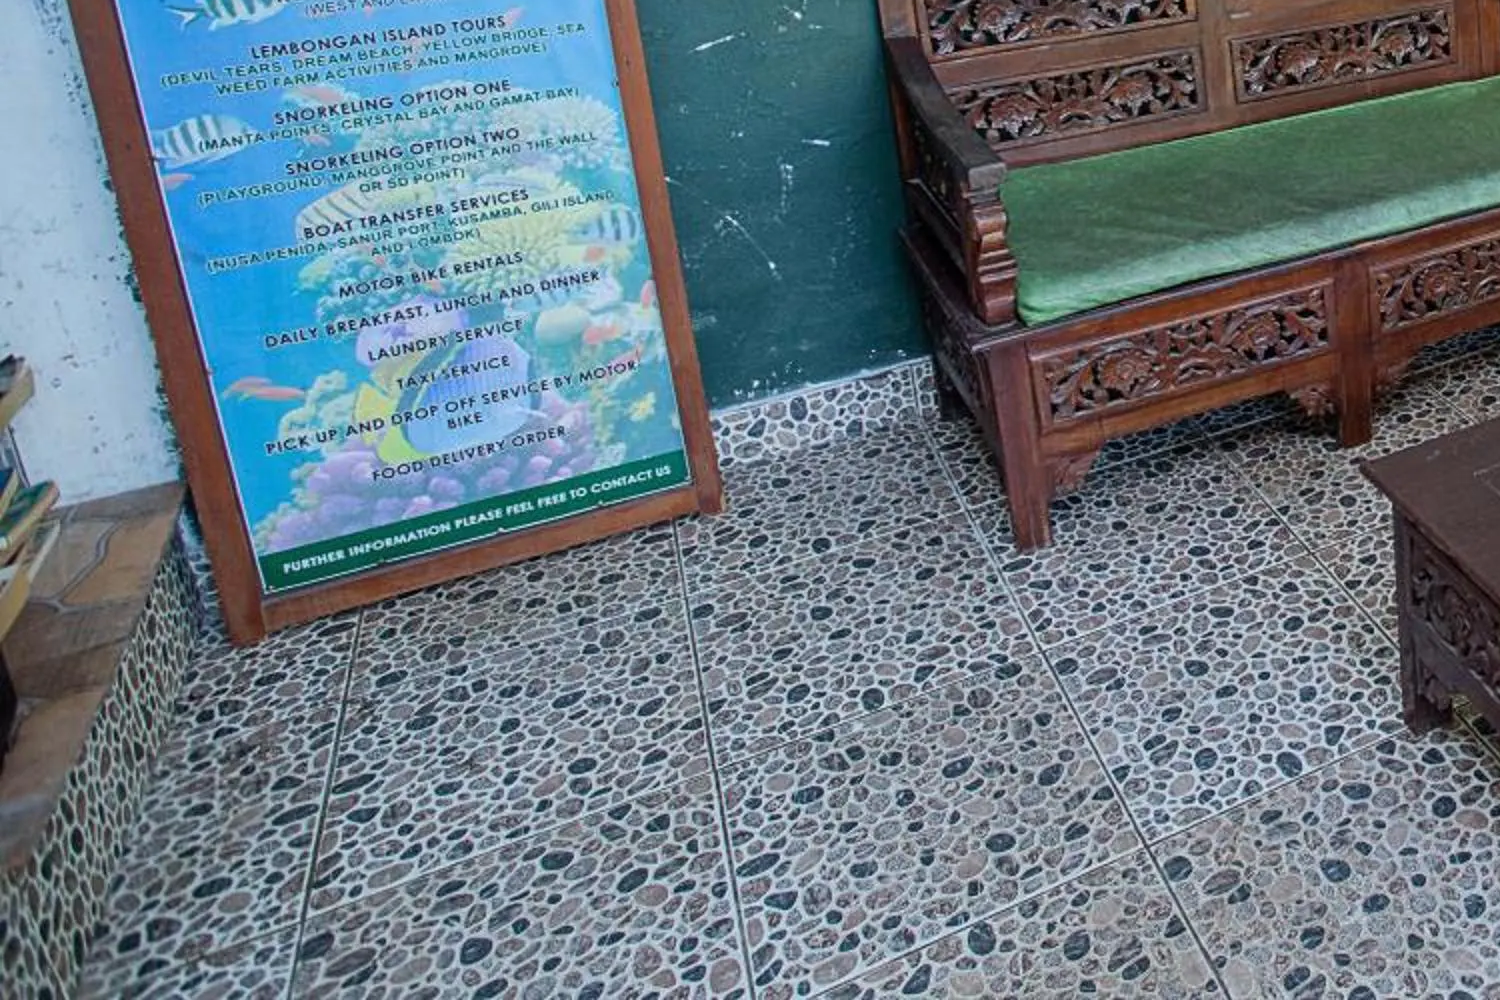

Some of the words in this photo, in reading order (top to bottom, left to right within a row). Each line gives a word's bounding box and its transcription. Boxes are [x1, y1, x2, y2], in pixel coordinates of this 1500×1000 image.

[305, 0, 356, 17] (WEST
[160, 74, 215, 89] (DEVIL
[292, 53, 352, 70] DREAM
[424, 34, 486, 52] YELLOW
[557, 22, 585, 36] SEA
[251, 32, 375, 59] LEMBONGAN
[383, 24, 446, 42] ISLAND
[452, 16, 506, 34] TOURS
[215, 79, 267, 95] WEED
[273, 71, 319, 87] FARM
[325, 61, 417, 82] ACTIVITIES
[418, 54, 449, 69] AND
[455, 44, 547, 64] MANGROVE)
[199, 134, 265, 153] (MANTA
[341, 111, 415, 131] CRYSTAL
[419, 105, 447, 119] BAY
[453, 99, 485, 113] AND
[489, 91, 540, 108] GAMAT
[274, 97, 393, 125] SNORKELING
[400, 87, 467, 107] OPTION
[473, 79, 511, 95] ONE
[285, 145, 403, 176] SNORKELING
[409, 134, 476, 155] OPTION
[482, 127, 520, 142] TWO
[332, 156, 438, 182] MANGGROVE
[441, 149, 484, 165] POINT
[491, 143, 521, 157] AND
[526, 137, 555, 151] THE
[559, 131, 598, 146] WALL
[359, 181, 382, 193] OR
[387, 175, 409, 189] SD
[413, 168, 465, 184] POINT)
[206, 253, 262, 275] (NUSA
[338, 230, 393, 249] SANUR
[449, 207, 528, 227] KUSAMBA,
[562, 190, 614, 208] ISLAND
[304, 218, 352, 240] BOAT
[360, 201, 445, 228] TRANSFER
[451, 188, 529, 212] SERVICES
[371, 243, 403, 258] AND
[408, 227, 481, 250] LOMBOK)
[338, 274, 404, 299] MOTOR
[411, 265, 447, 284] BIKE
[453, 251, 524, 276] RENTALS
[265, 327, 318, 349] DAILY
[325, 305, 430, 335] BREAKFAST,
[435, 292, 491, 313] LUNCH
[499, 283, 535, 300] AND
[540, 270, 600, 291] DINNER
[367, 335, 449, 362] LAUNDRY
[455, 318, 523, 343] SERVICE
[396, 372, 435, 391] TAXI
[440, 355, 511, 379] SERVICE
[265, 434, 310, 455] PICK
[315, 428, 337, 444] UP
[345, 418, 384, 437] AND
[390, 405, 438, 426] DROP
[444, 397, 476, 414] OFF
[481, 379, 550, 404] SERVICE
[553, 374, 573, 390] BY
[579, 360, 638, 382] MOTOR
[446, 410, 483, 430] BIKE
[372, 460, 424, 482] FOOD
[429, 439, 506, 469] DELIVERY
[511, 424, 567, 448] ORDER
[283, 549, 346, 575] FURTHER
[348, 521, 451, 558] INFORMATION
[454, 506, 503, 530] PLEASE
[505, 500, 534, 519] FEEL
[537, 492, 567, 509] FREE
[568, 485, 587, 500] TO
[590, 472, 653, 496] CONTACT
[654, 464, 672, 478] US
